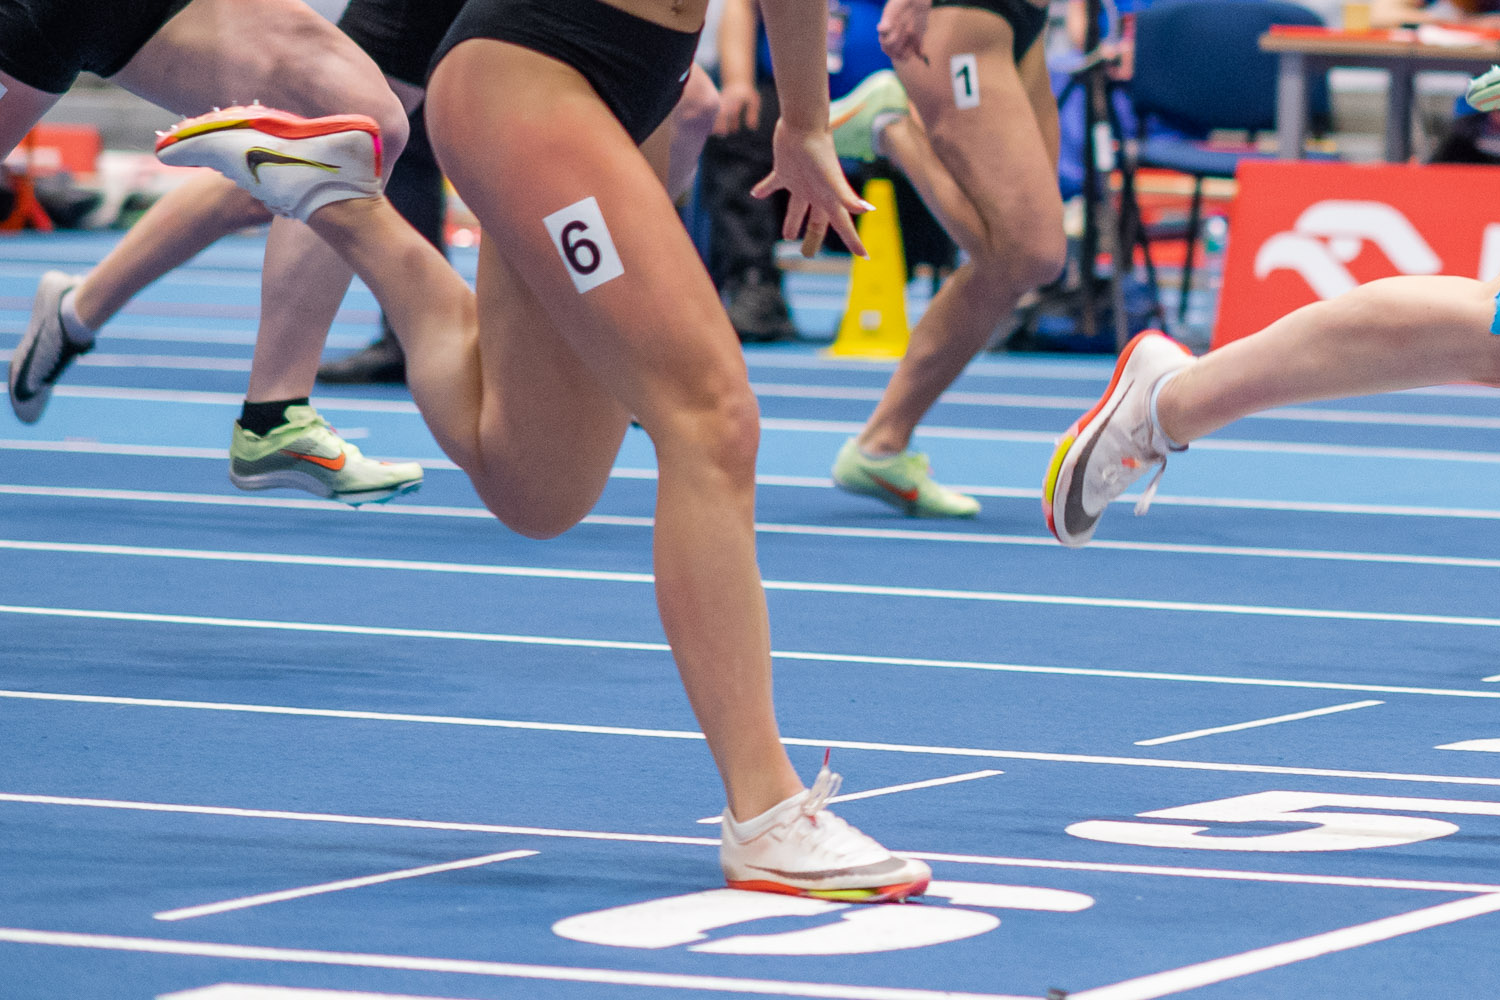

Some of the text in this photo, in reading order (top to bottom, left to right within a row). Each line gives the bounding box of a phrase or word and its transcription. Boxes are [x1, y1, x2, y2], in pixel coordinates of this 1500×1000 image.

[956, 64, 973, 97] 1
[560, 220, 601, 275] 6
[551, 879, 1097, 956] 6
